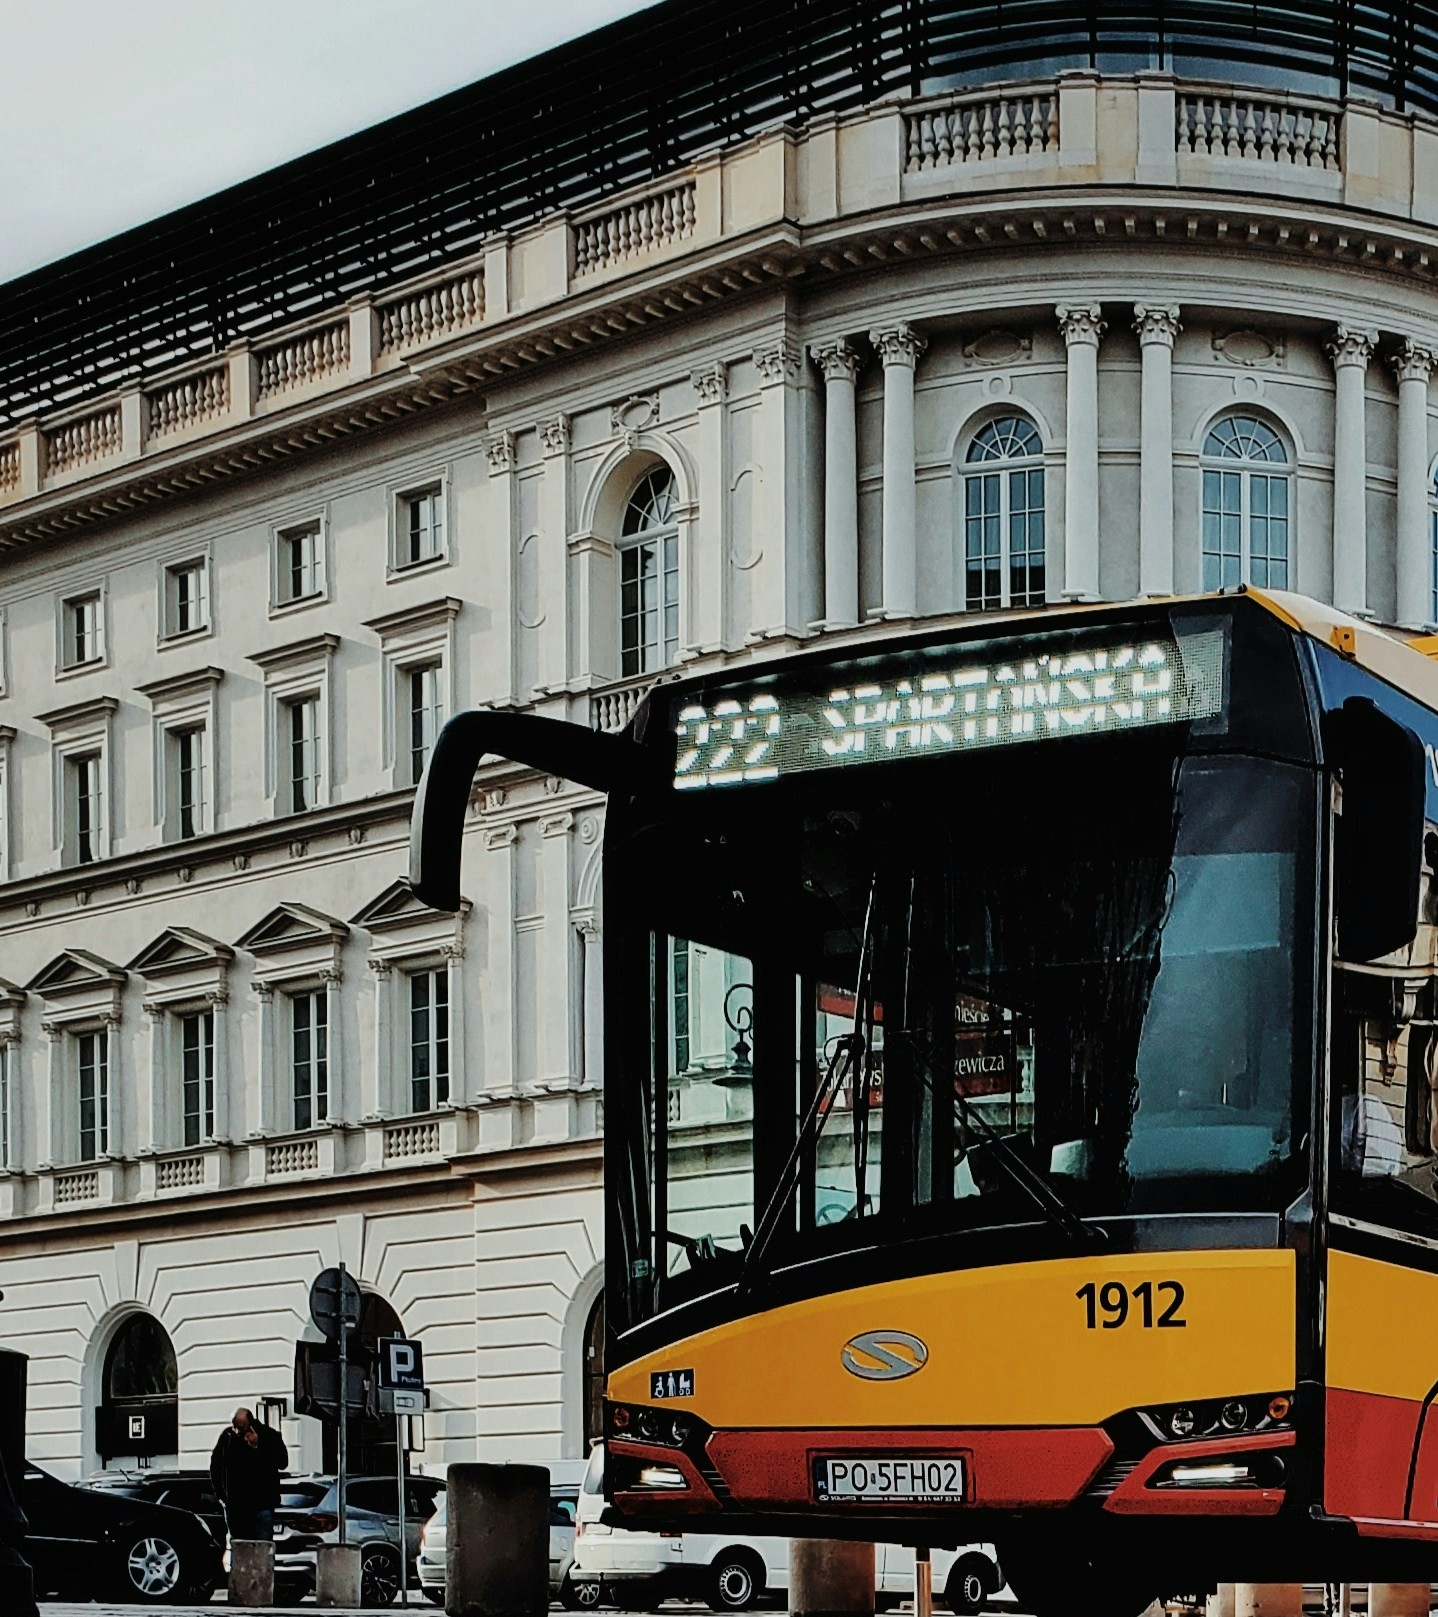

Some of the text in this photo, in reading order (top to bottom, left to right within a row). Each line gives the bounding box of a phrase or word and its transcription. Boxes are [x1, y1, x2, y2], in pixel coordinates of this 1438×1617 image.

[1076, 1281, 1186, 1328] 1912
[390, 1344, 414, 1382] P
[831, 1463, 958, 1492] PO 5FH02
